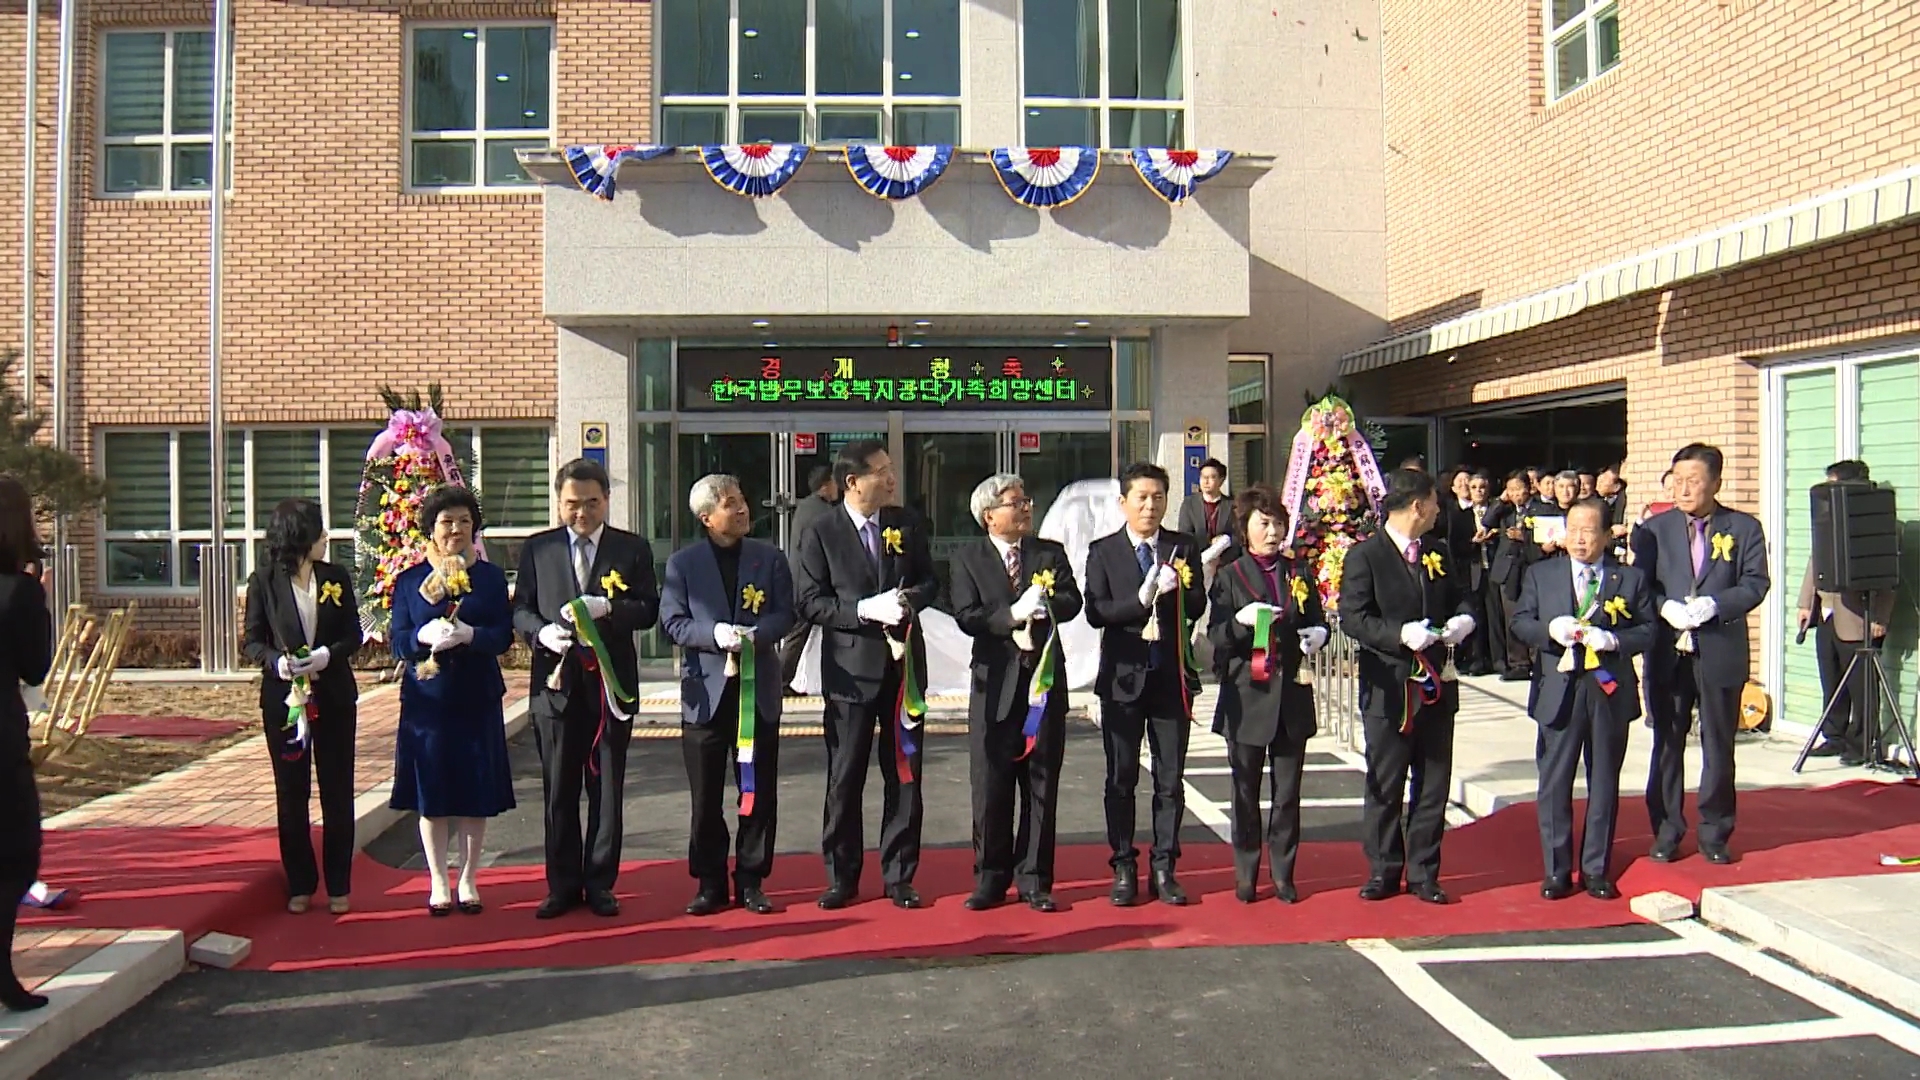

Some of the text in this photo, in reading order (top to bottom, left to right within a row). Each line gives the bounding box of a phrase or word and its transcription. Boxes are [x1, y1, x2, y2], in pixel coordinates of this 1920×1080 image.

[761, 357, 781, 379] 경
[833, 357, 853, 379] 개
[930, 357, 950, 379] 청
